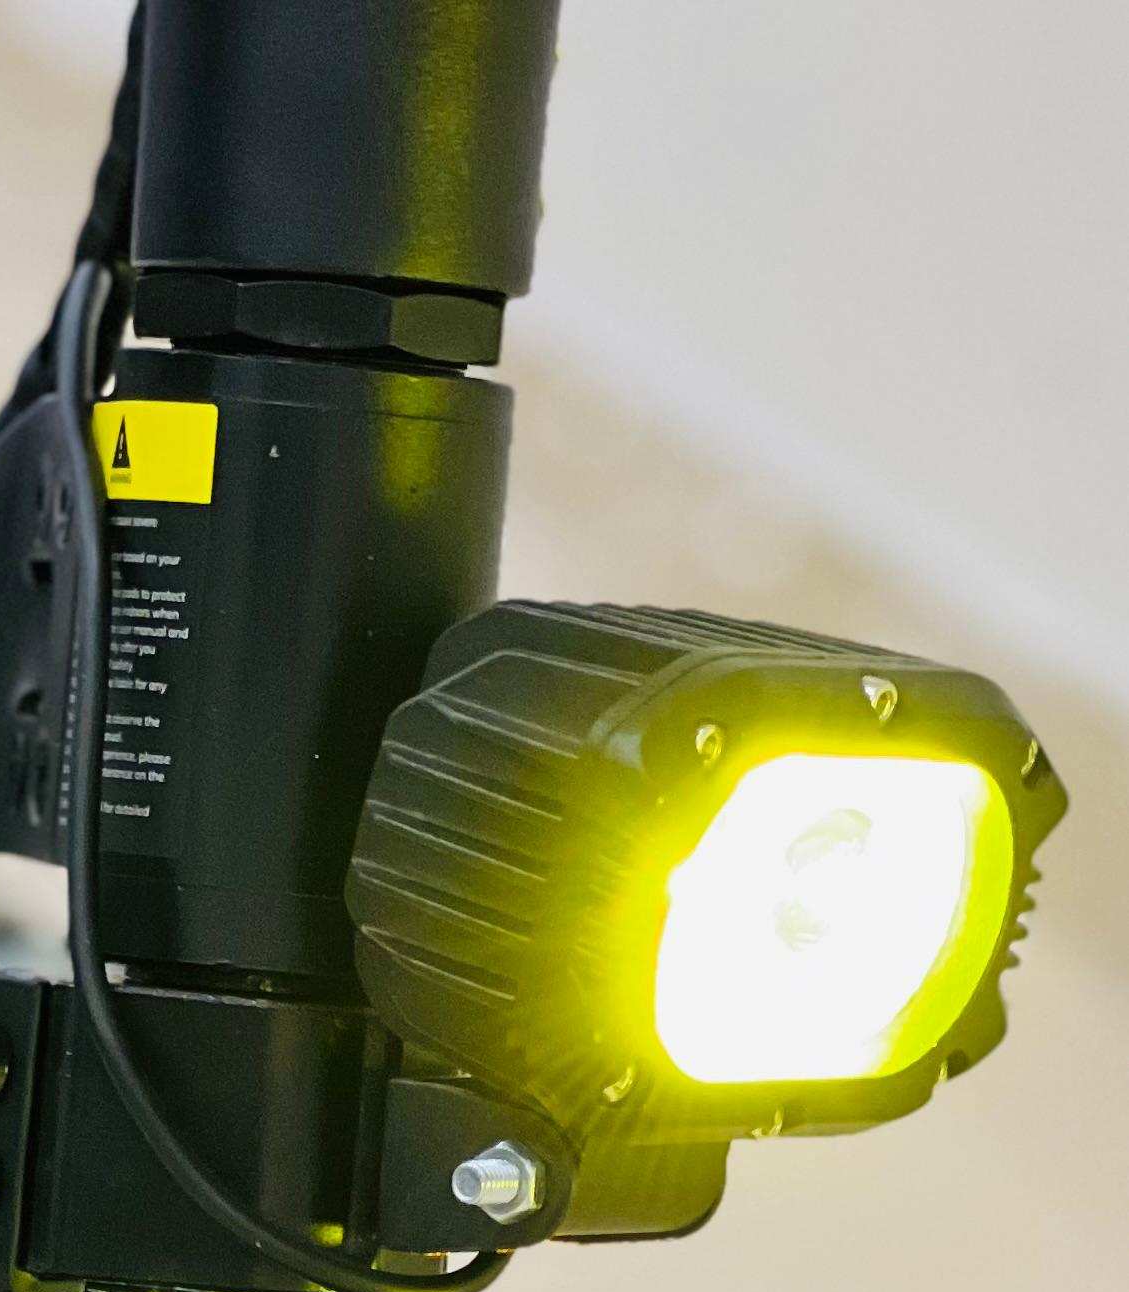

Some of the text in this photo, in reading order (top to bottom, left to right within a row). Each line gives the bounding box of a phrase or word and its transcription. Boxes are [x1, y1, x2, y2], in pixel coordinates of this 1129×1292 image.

[158, 556, 181, 567] your
[151, 591, 186, 602] protect
[168, 627, 189, 639] and
[139, 645, 155, 656] you
[149, 682, 168, 694] any
